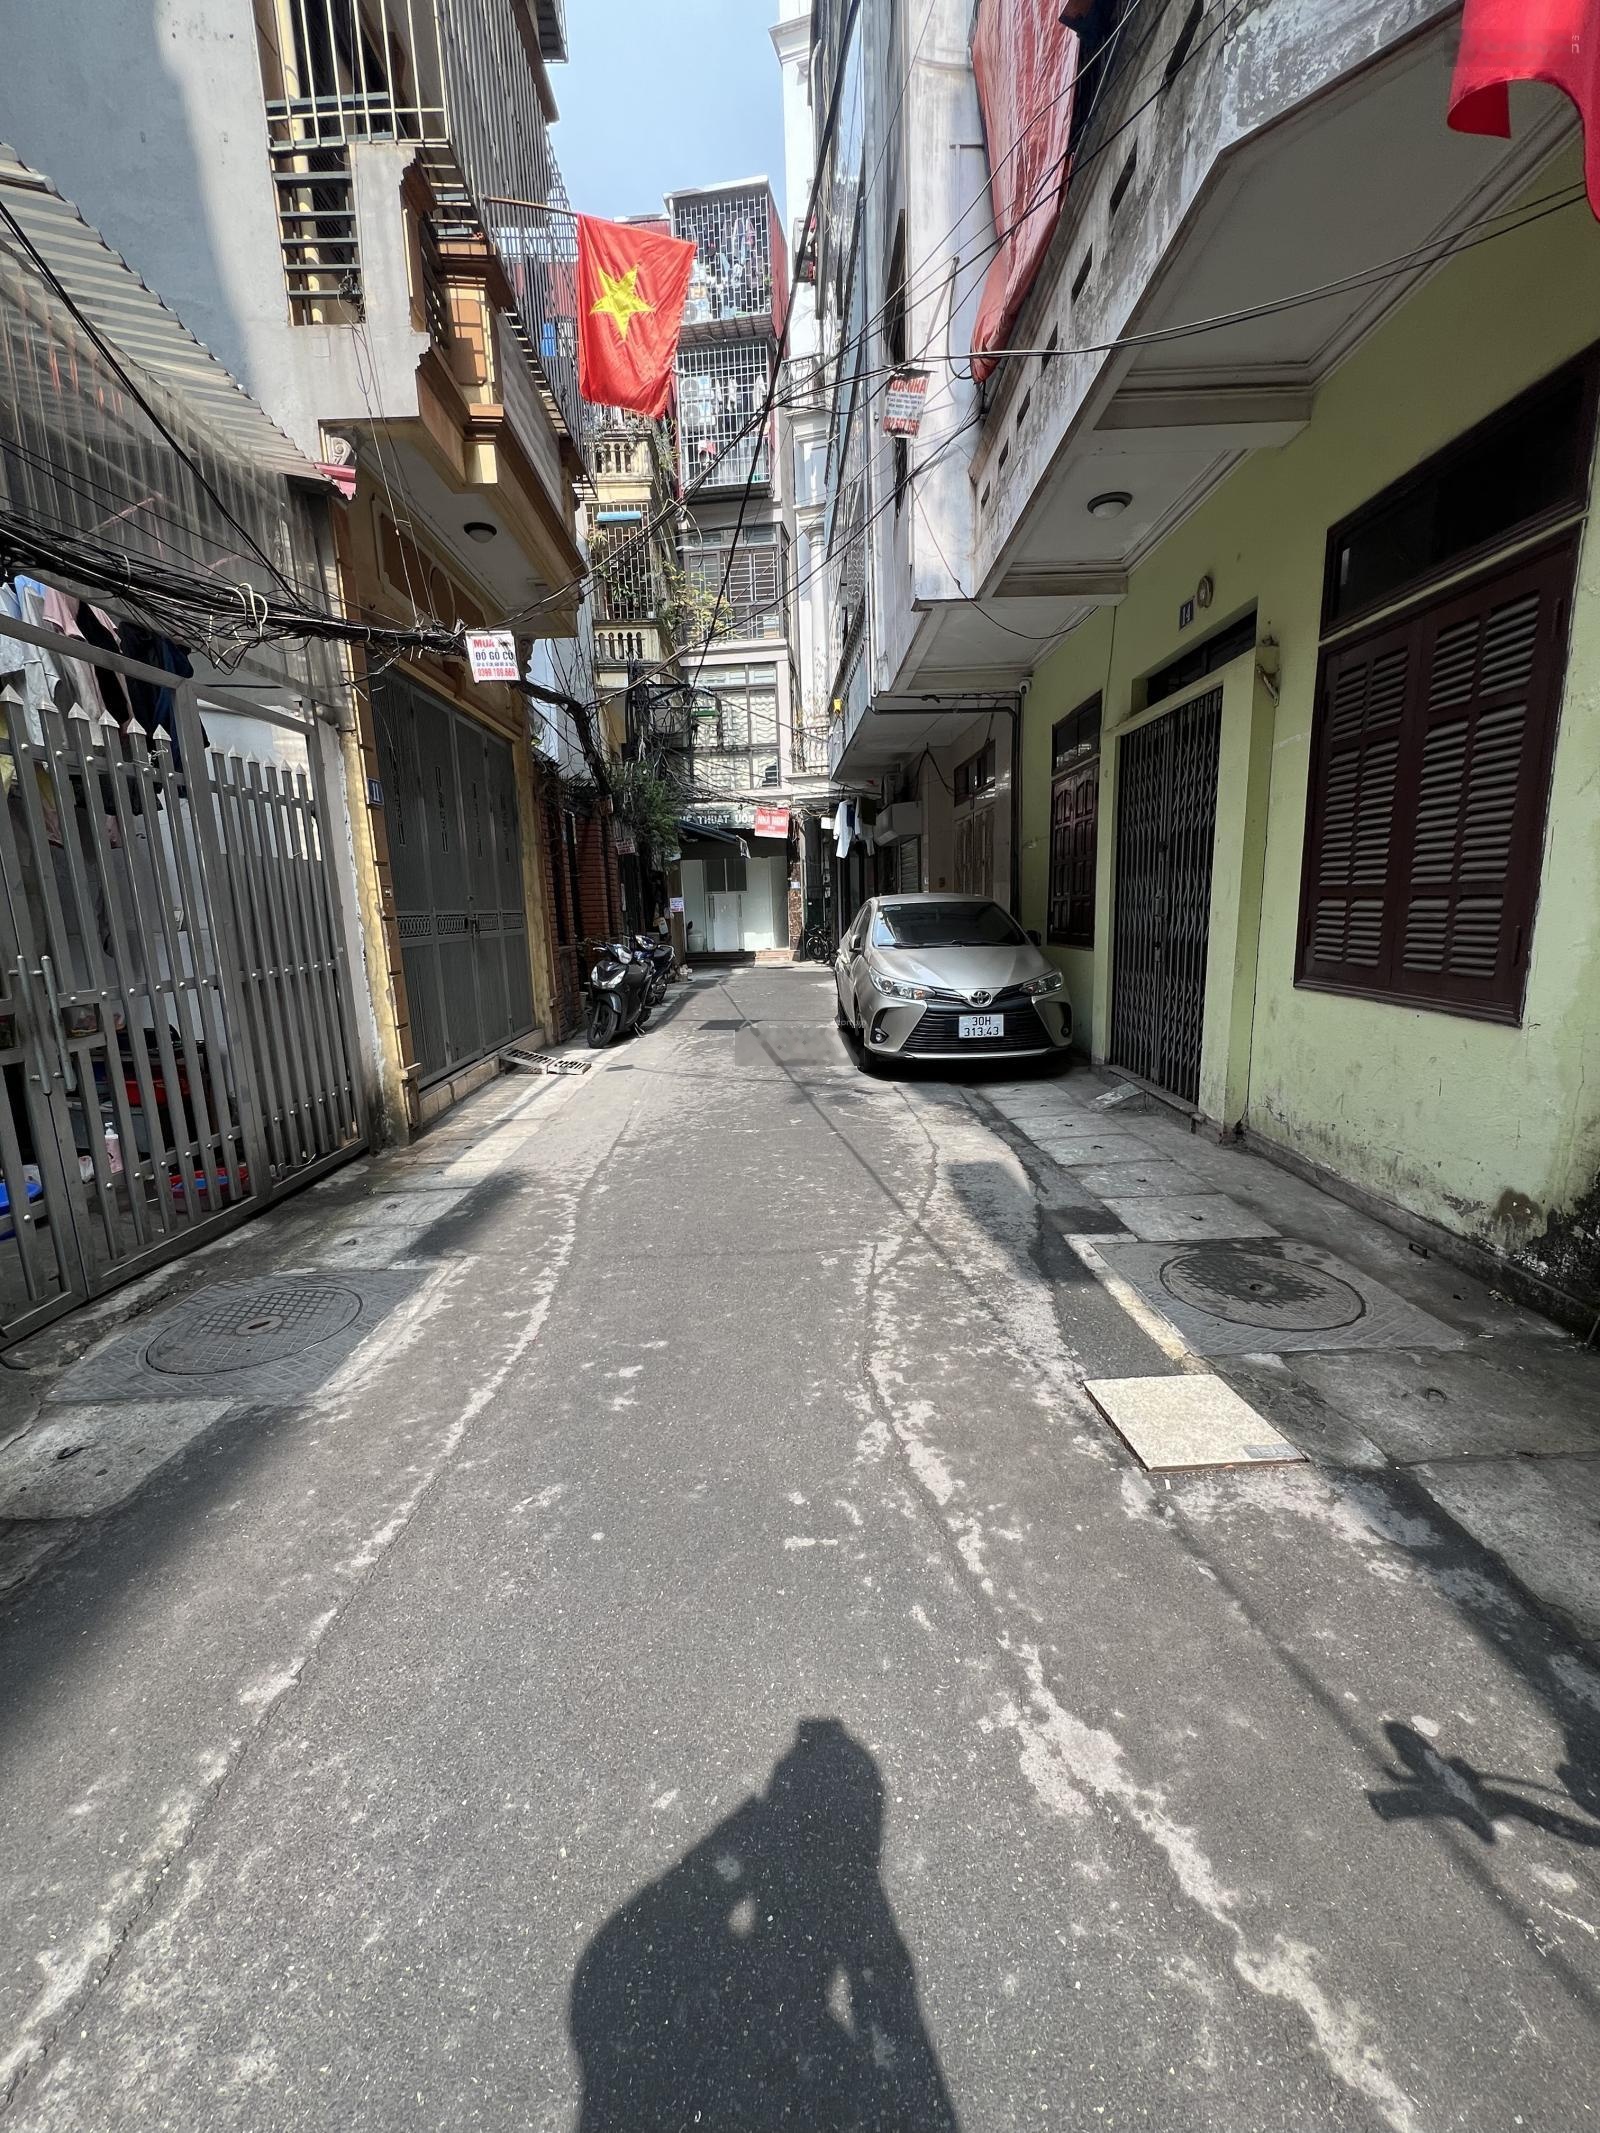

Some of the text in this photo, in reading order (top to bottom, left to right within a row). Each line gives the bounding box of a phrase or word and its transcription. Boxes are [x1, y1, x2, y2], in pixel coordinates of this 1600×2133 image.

[473, 639, 495, 648] MUA
[972, 1016, 991, 1026] 30H
[964, 1026, 999, 1037] 313.43
